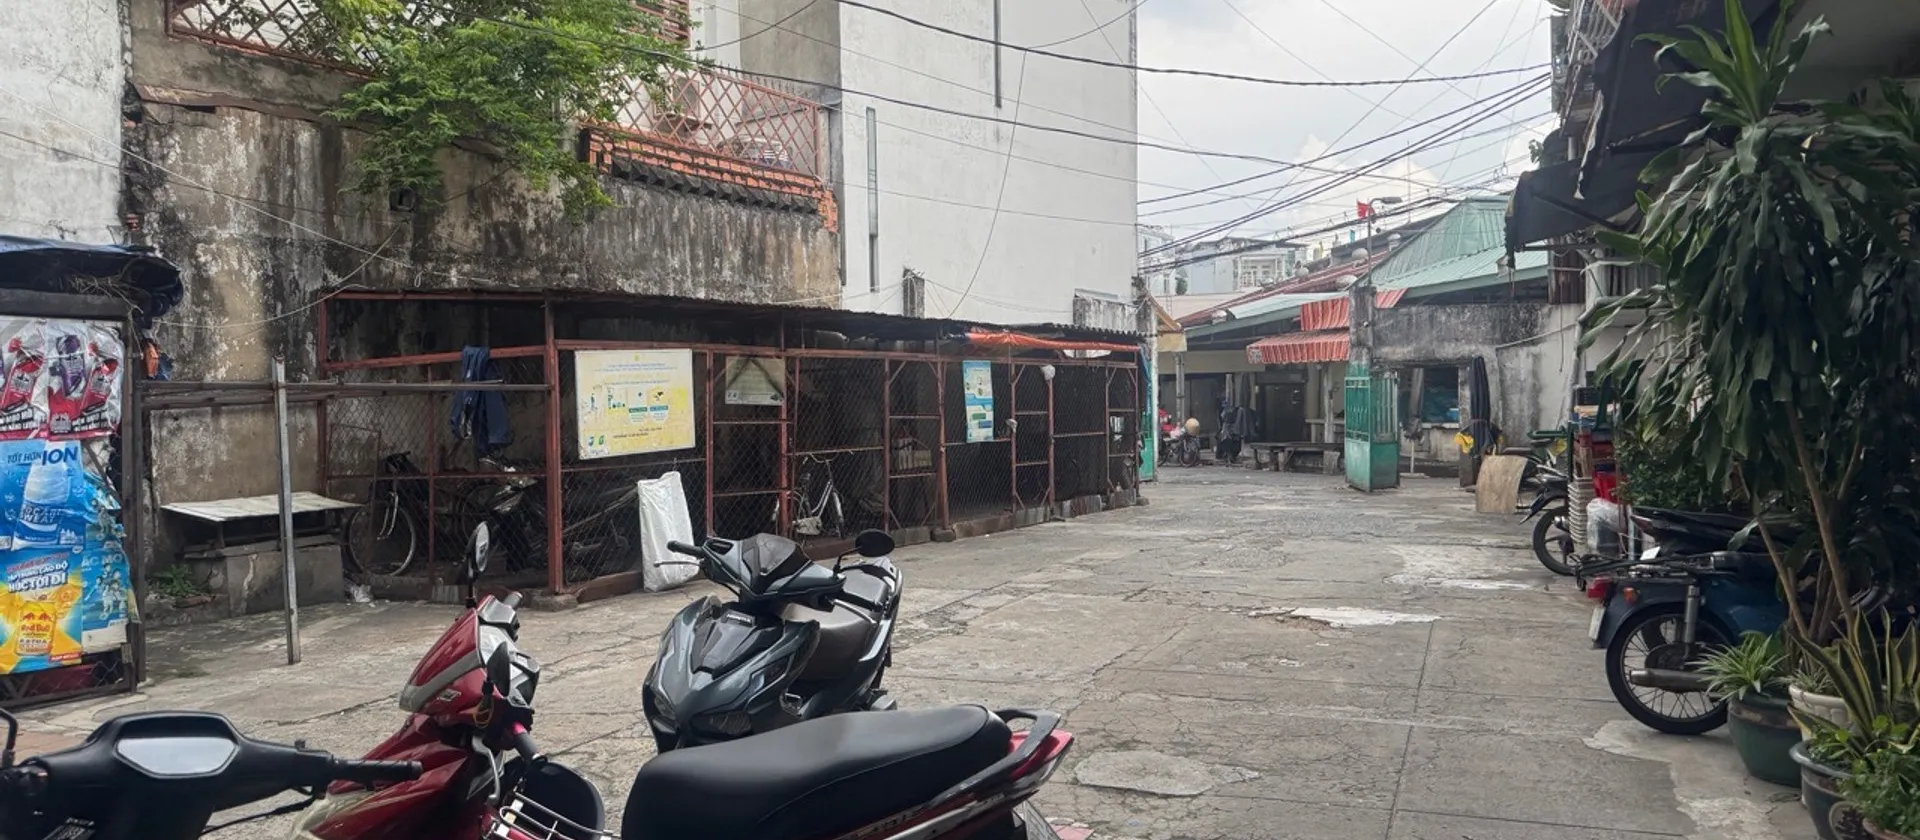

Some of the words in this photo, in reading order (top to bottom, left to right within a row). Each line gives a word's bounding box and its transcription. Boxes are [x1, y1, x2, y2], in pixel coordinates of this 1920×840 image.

[42, 446, 78, 466] ION
[39, 563, 55, 575] CAO
[20, 623, 36, 632] Red
[36, 623, 51, 632] Bull
